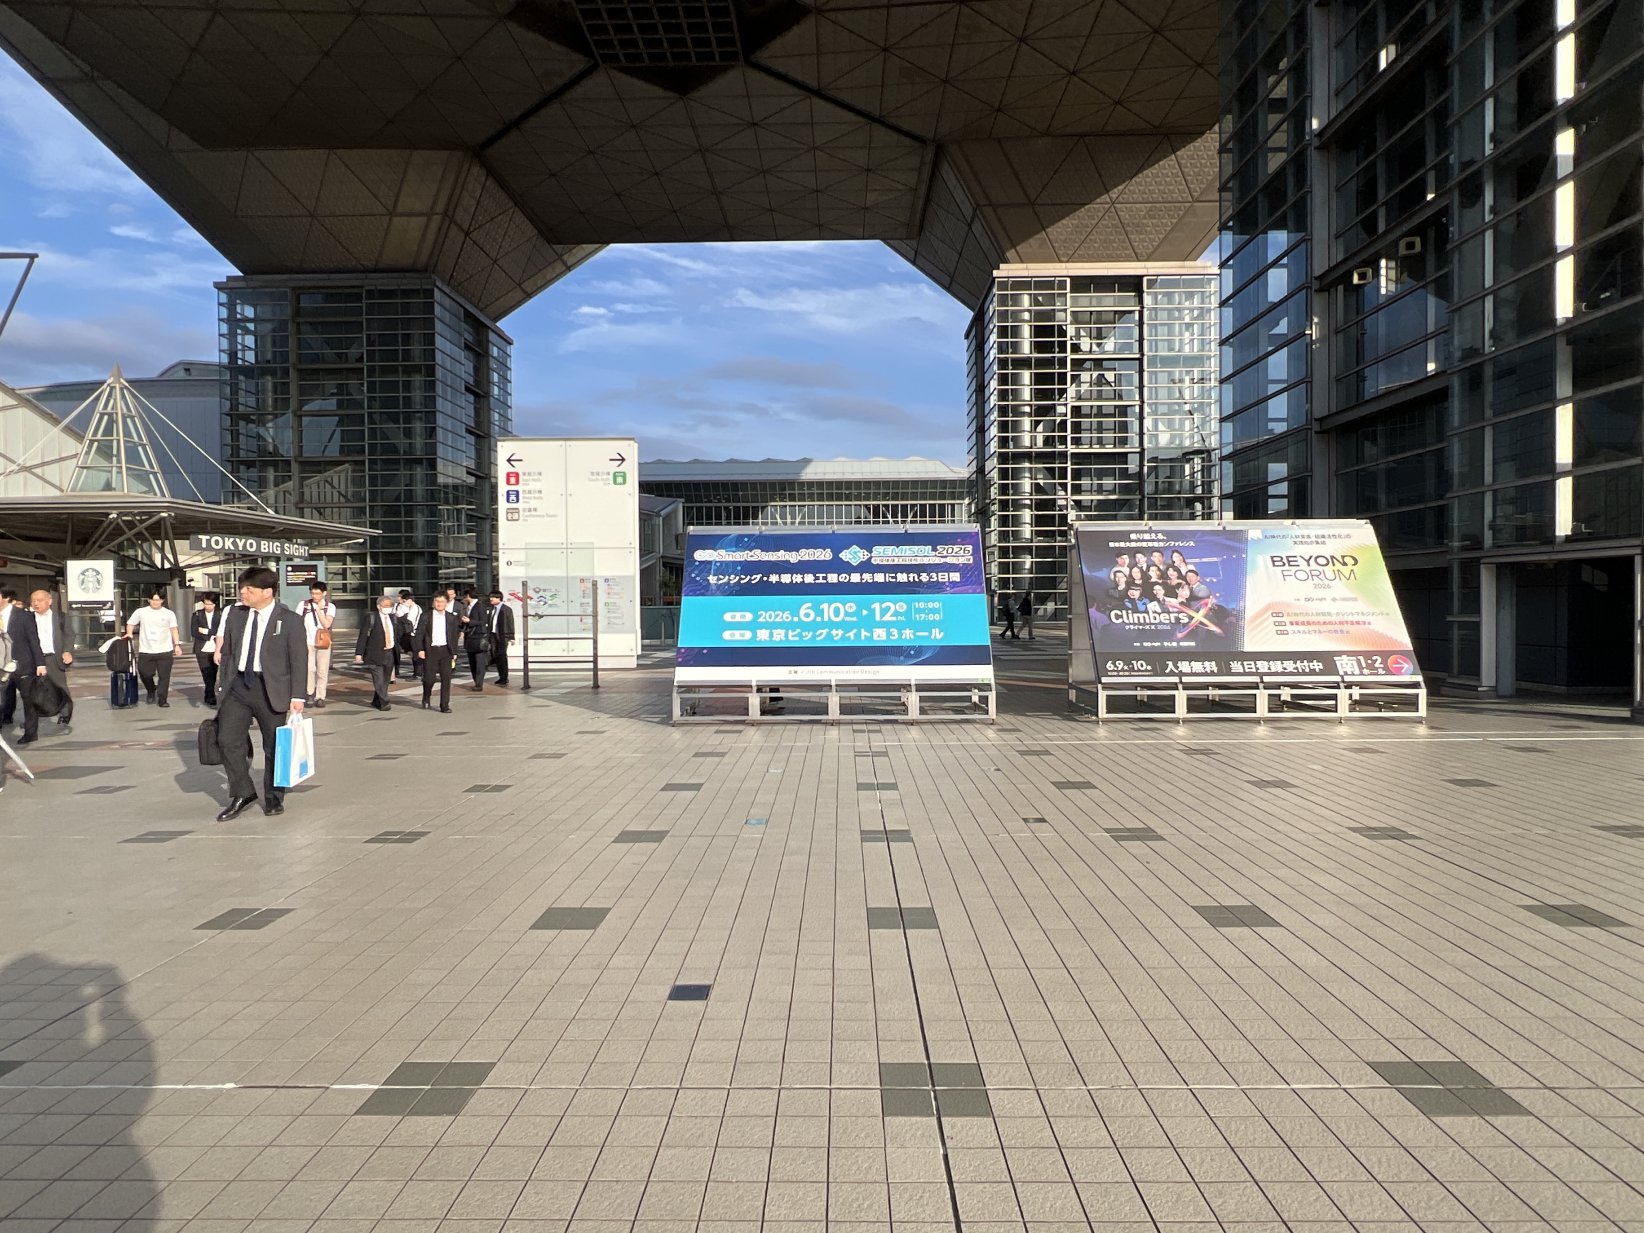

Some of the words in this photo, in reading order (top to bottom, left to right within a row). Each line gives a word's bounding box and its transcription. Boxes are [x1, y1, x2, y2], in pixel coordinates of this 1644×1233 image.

[197, 534, 256, 552] TOKYO
[260, 540, 281, 553] BIG
[284, 543, 309, 557] SIGHT
[872, 545, 935, 556] SEMISOL
[937, 545, 972, 556] 2026
[716, 549, 750, 561] Smart
[752, 549, 798, 562] Sensing
[799, 549, 833, 561] 2026
[1270, 554, 1359, 568] BEYOND
[707, 572, 961, 584] センシング・半導体後工程の最先端に触れる3日間
[1281, 569, 1357, 582] FORUM
[914, 601, 940, 609] 10:00
[915, 613, 940, 621] 17:00
[1110, 609, 1189, 624] Climbers
[756, 627, 944, 642] 東京ビッグサイト西3ホール
[1164, 660, 1218, 674] 入場無料
[1229, 659, 1324, 674] 当日登録受付中
[1334, 655, 1361, 676] 南
[1362, 667, 1386, 676] ホール
